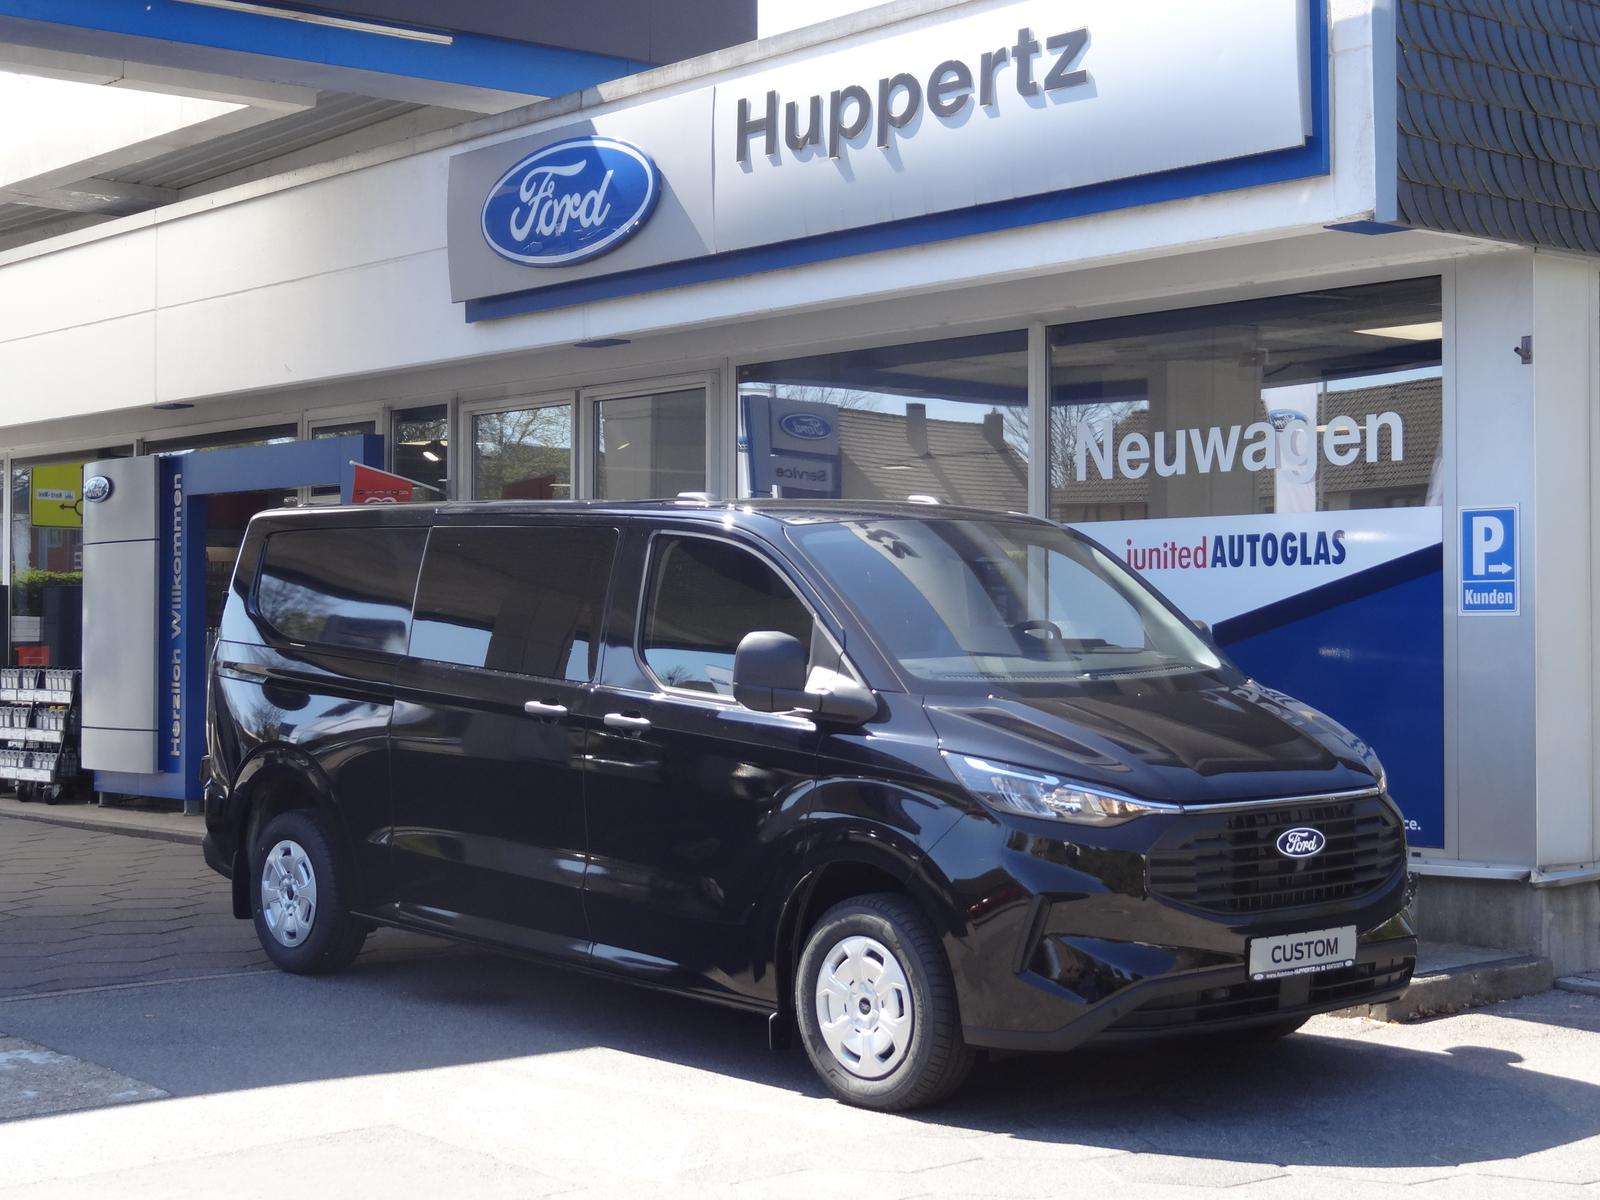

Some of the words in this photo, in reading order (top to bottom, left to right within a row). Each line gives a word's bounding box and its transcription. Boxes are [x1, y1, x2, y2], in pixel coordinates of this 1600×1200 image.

[736, 27, 1092, 162] Huppertz
[510, 159, 614, 242] Ford
[1075, 412, 1404, 484] Neuwagen
[171, 473, 183, 640] Willkommen
[1211, 529, 1346, 569] AUTOGLAS
[1472, 516, 1504, 575] P
[1466, 589, 1513, 604] Kunden
[1286, 832, 1317, 853] Ford
[1271, 937, 1338, 963] CUSTOM
